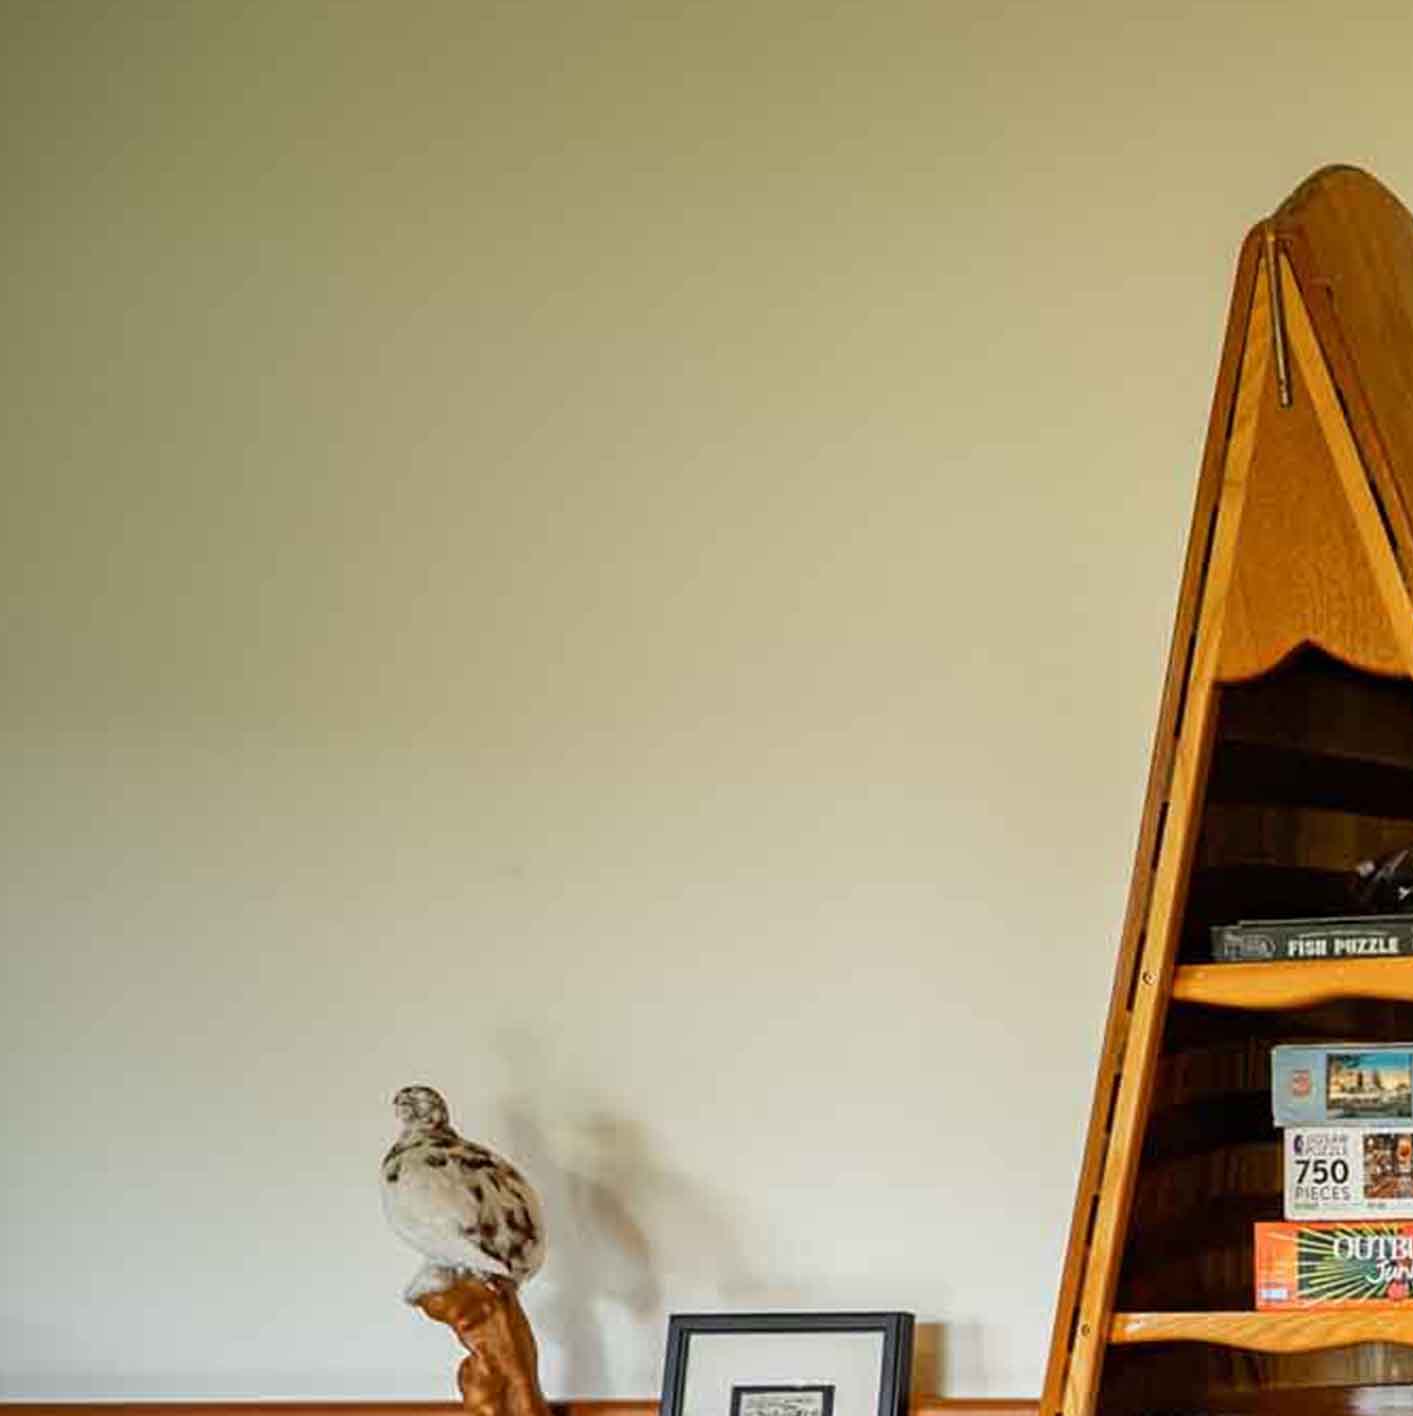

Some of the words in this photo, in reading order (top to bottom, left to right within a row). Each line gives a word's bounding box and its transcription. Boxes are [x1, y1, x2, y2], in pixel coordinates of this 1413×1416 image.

[1287, 938, 1327, 956] FISH
[1333, 935, 1399, 955] PUZZLE
[1295, 1159, 1349, 1184] 750
[1295, 1186, 1351, 1201] PIECES
